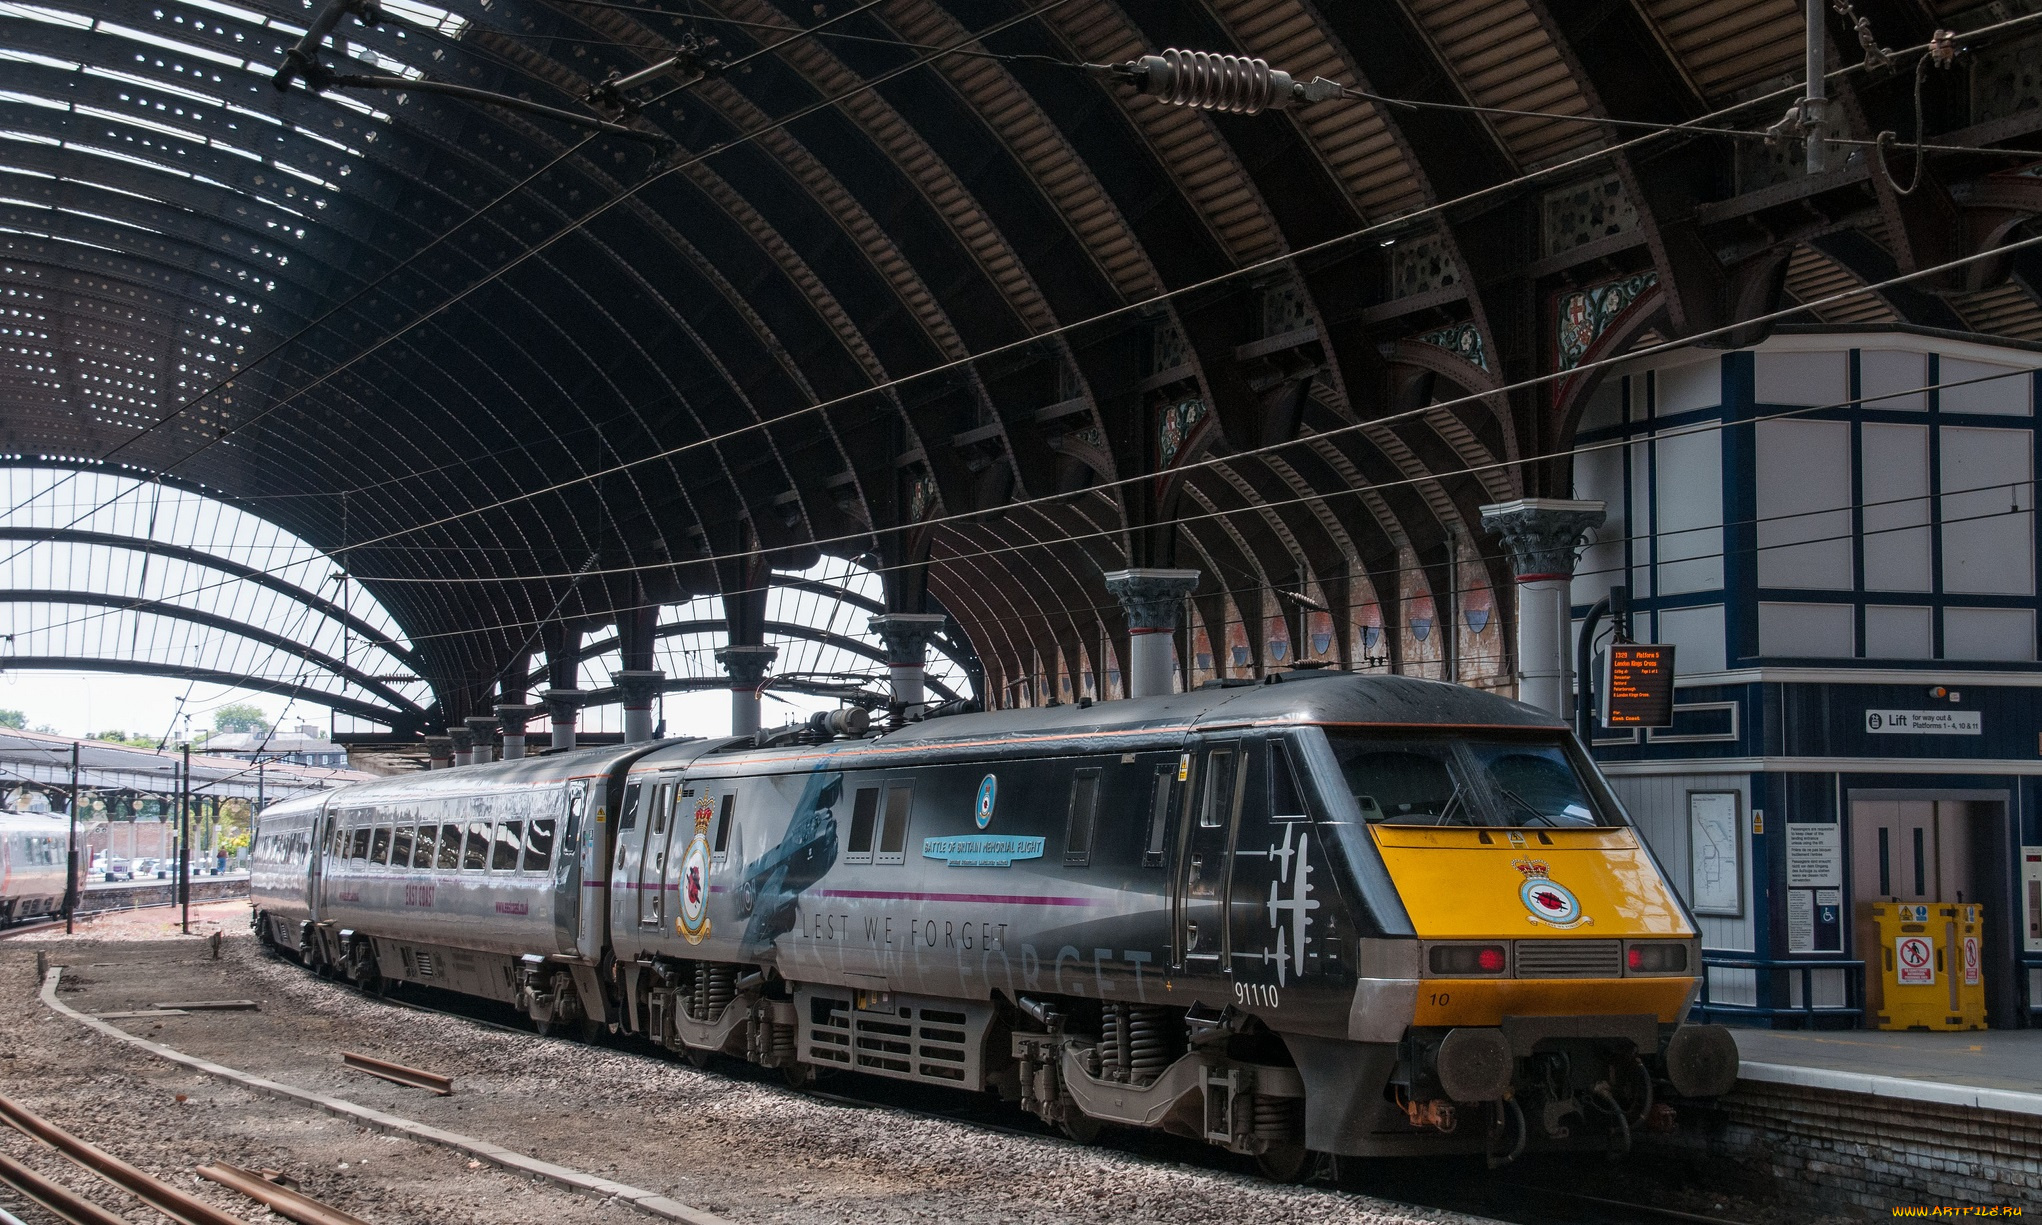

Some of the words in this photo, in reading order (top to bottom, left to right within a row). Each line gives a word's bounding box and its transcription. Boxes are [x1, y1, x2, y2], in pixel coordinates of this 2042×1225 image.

[1888, 715, 1907, 726] Lift
[924, 842, 945, 853] BATTLE
[948, 842, 956, 853] OF
[957, 842, 980, 853] BRITAIN
[983, 842, 1014, 853] MEMORIAL
[1017, 841, 1041, 853] FLIGHT
[406, 884, 418, 906] EAST
[419, 885, 435, 908] COAST
[802, 914, 848, 940] LEST
[864, 916, 892, 944] WE
[911, 919, 1008, 952] FORGET
[1235, 982, 1279, 1008] 91110
[1429, 993, 1449, 1006] 10
